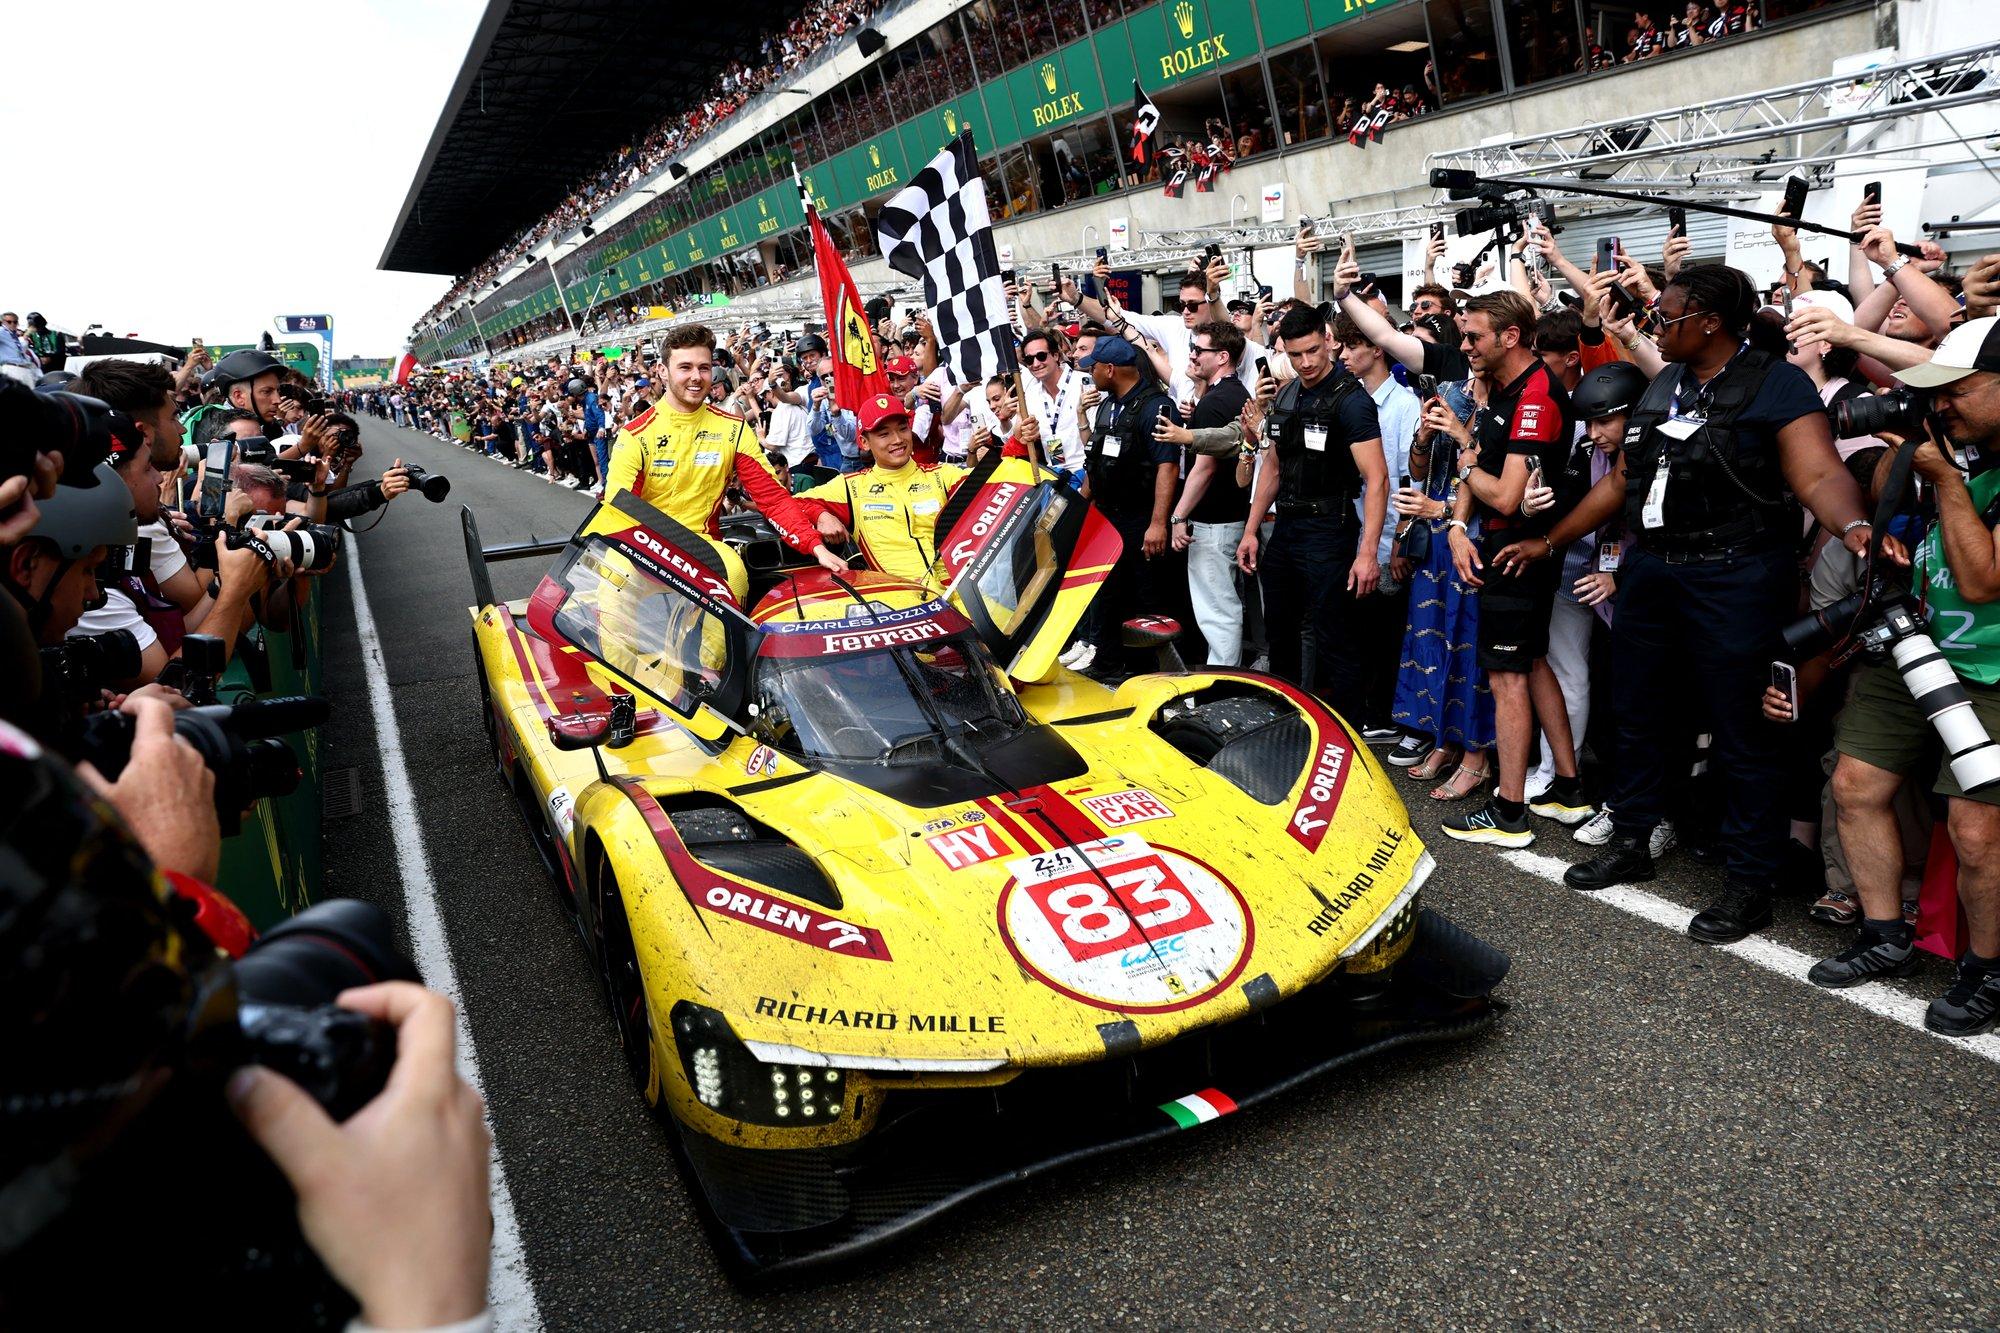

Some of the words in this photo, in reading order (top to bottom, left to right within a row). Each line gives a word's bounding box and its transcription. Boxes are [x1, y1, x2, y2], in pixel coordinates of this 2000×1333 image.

[1160, 34, 1229, 79] ROLEX
[1032, 92, 1084, 127] ROLEX
[866, 167, 898, 192] ROLEX
[972, 483, 1017, 536] ORLEN
[633, 530, 699, 579] ORLEN
[633, 552, 658, 572] KUBICA
[672, 577, 700, 599] HANSON
[781, 617, 873, 633] CHARLES
[878, 608, 926, 624] POZZI
[822, 619, 949, 653] Ferrari
[1310, 743, 1346, 802] ORLEN
[1089, 789, 1151, 811] HYPER
[1099, 799, 1168, 824] CAR
[926, 819, 953, 832] FIA
[929, 824, 999, 869] HY
[1047, 864, 1193, 944] 83
[1307, 871, 1374, 938] RICHARD
[1366, 827, 1403, 875] MILLE
[706, 887, 811, 933] ORLEN
[755, 996, 897, 1030] RICHARD
[909, 1015, 1005, 1033] MILLE
